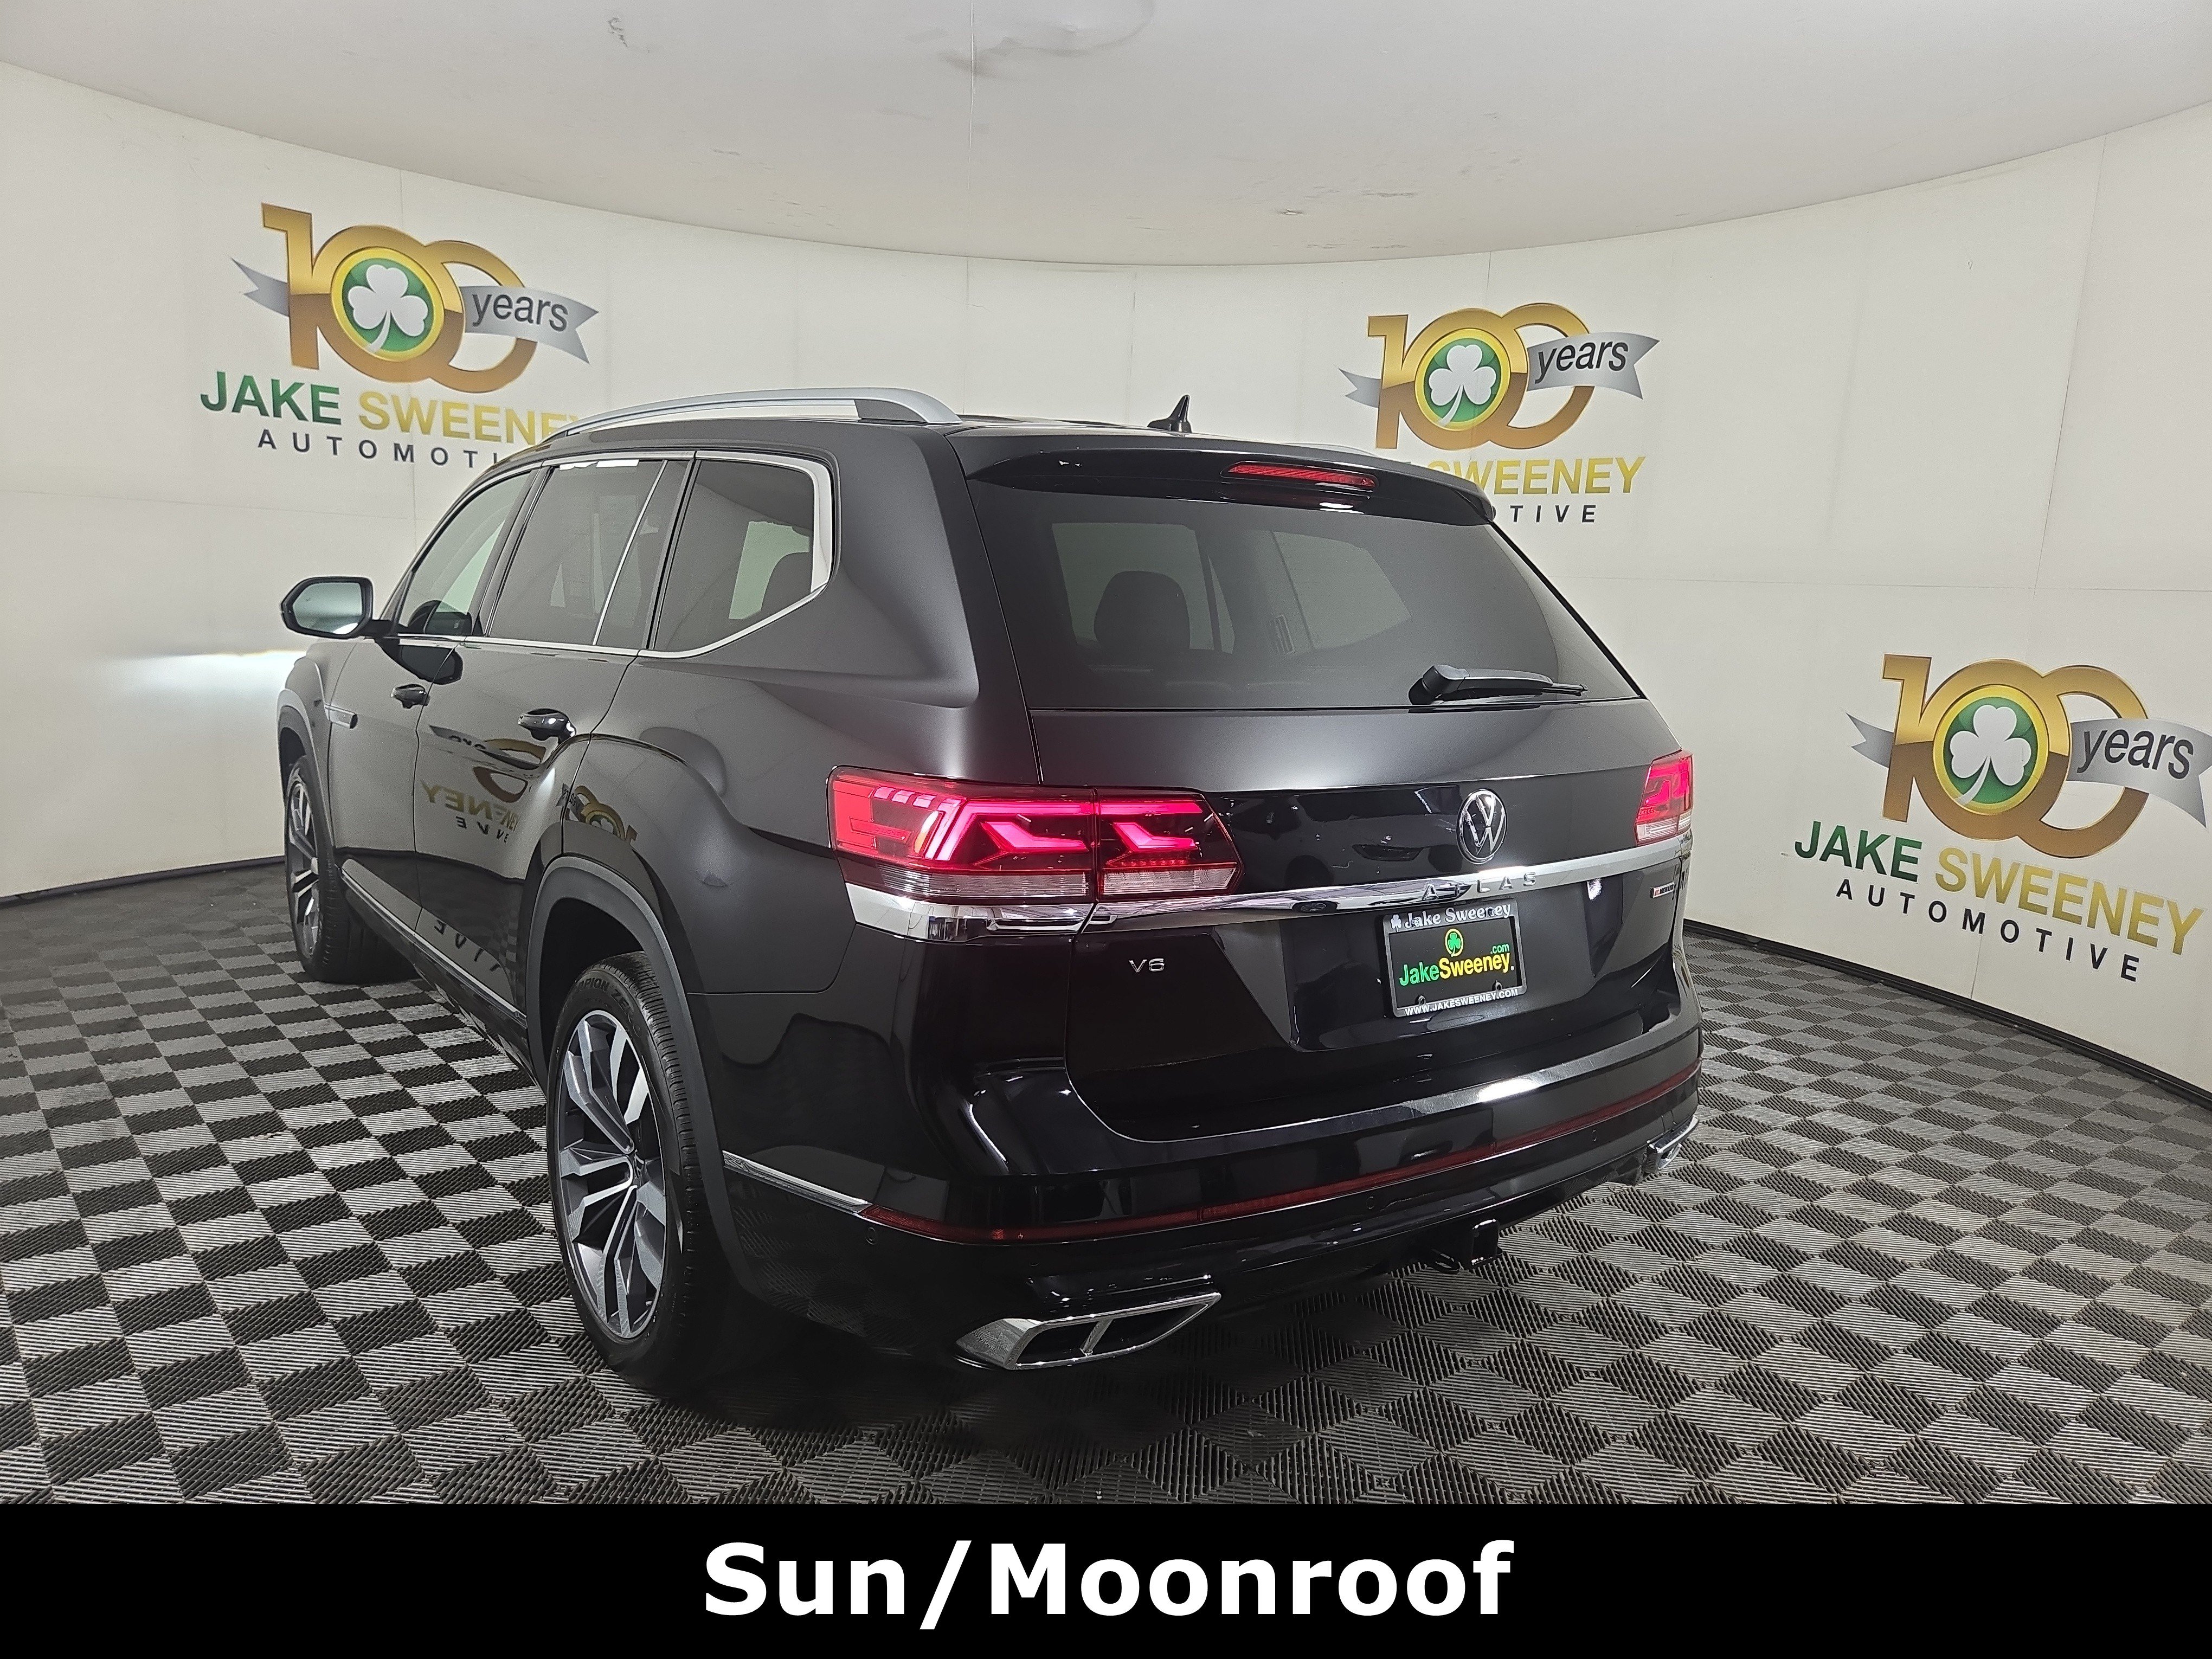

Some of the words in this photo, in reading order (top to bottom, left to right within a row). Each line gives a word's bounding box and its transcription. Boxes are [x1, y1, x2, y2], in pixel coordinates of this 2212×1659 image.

[261, 202, 538, 394] 100
[472, 291, 569, 332] years
[1368, 303, 1594, 451] 100
[1534, 340, 1629, 384] years
[201, 371, 343, 426] JAKE
[359, 391, 579, 446] SWEENE
[258, 428, 498, 470] AUTOMOTI
[1491, 504, 1597, 523] TIVE
[1882, 653, 2149, 859] 100
[2076, 726, 2195, 780] years
[1421, 871, 1536, 901] ATLAS
[1795, 820, 1923, 883] JAKE
[1934, 847, 2205, 956] SWEENEY
[1404, 910, 1441, 929] Jake
[1445, 903, 1511, 923] Sweeney
[1835, 878, 2140, 982] AUTOMOTIVE
[1129, 958, 1165, 973] V6
[1490, 943, 1510, 954] .com
[1404, 988, 1519, 1017] WWW.JAKESWEENEY.COM
